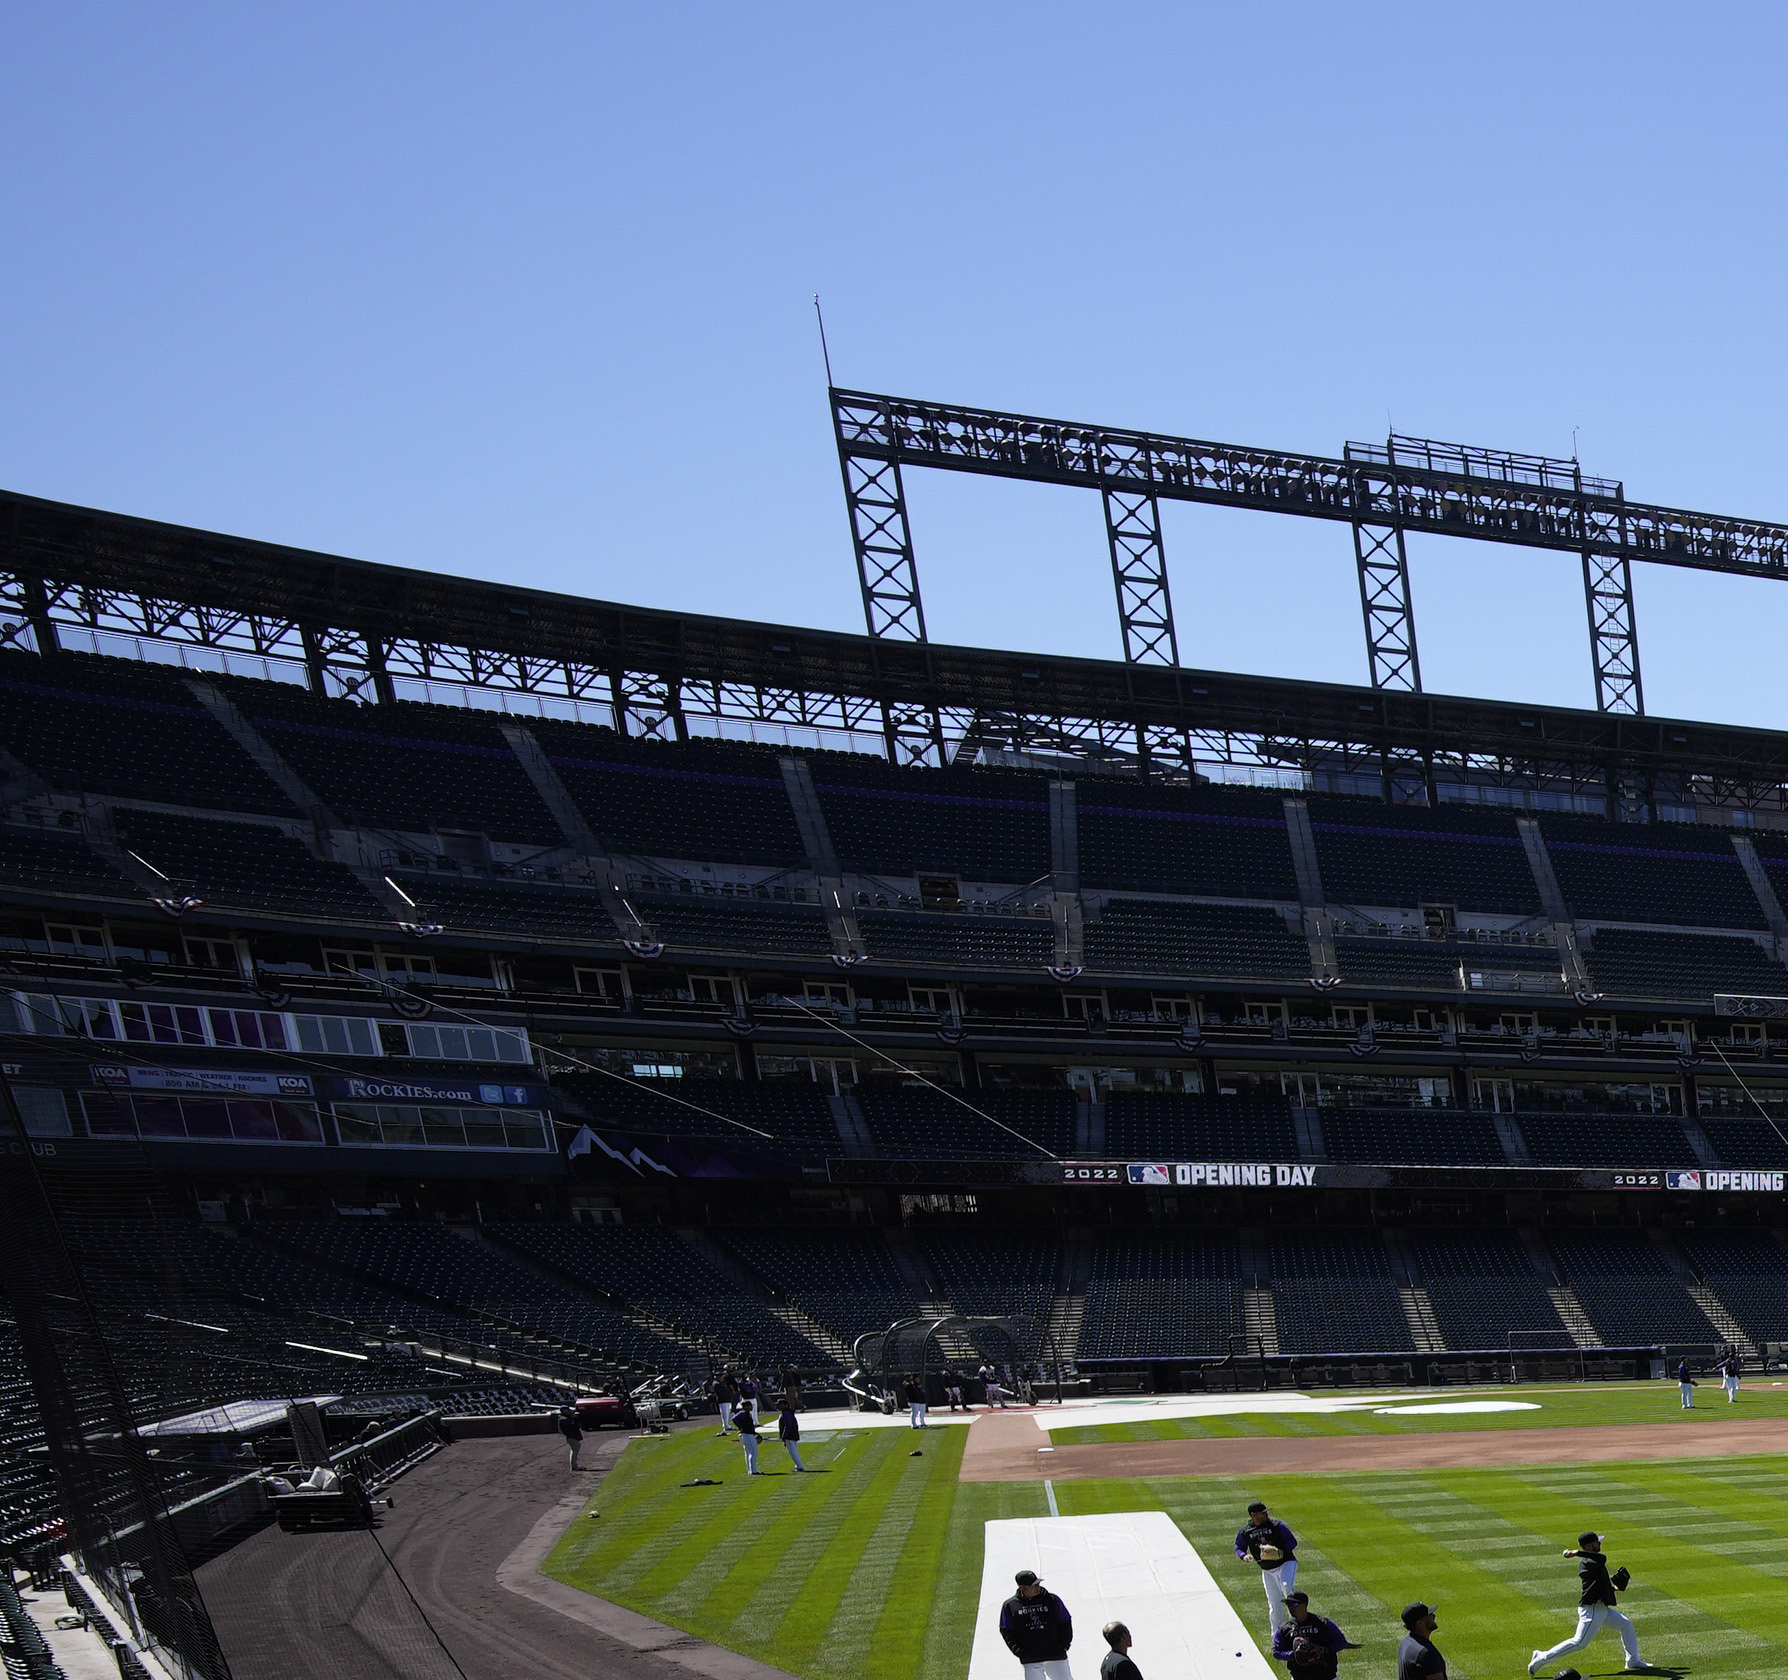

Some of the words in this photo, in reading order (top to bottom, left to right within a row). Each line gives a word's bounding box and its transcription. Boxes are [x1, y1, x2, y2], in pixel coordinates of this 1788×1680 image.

[97, 1066, 127, 1079] KOA
[278, 1076, 309, 1089] KOA
[344, 1077, 473, 1101] ROCKIES.com
[1064, 1168, 1119, 1179] 2022
[1176, 1165, 1271, 1186] OPENING
[1276, 1166, 1316, 1186] DAY
[1614, 1175, 1659, 1185] 2022
[1706, 1172, 1784, 1191] OPENING
